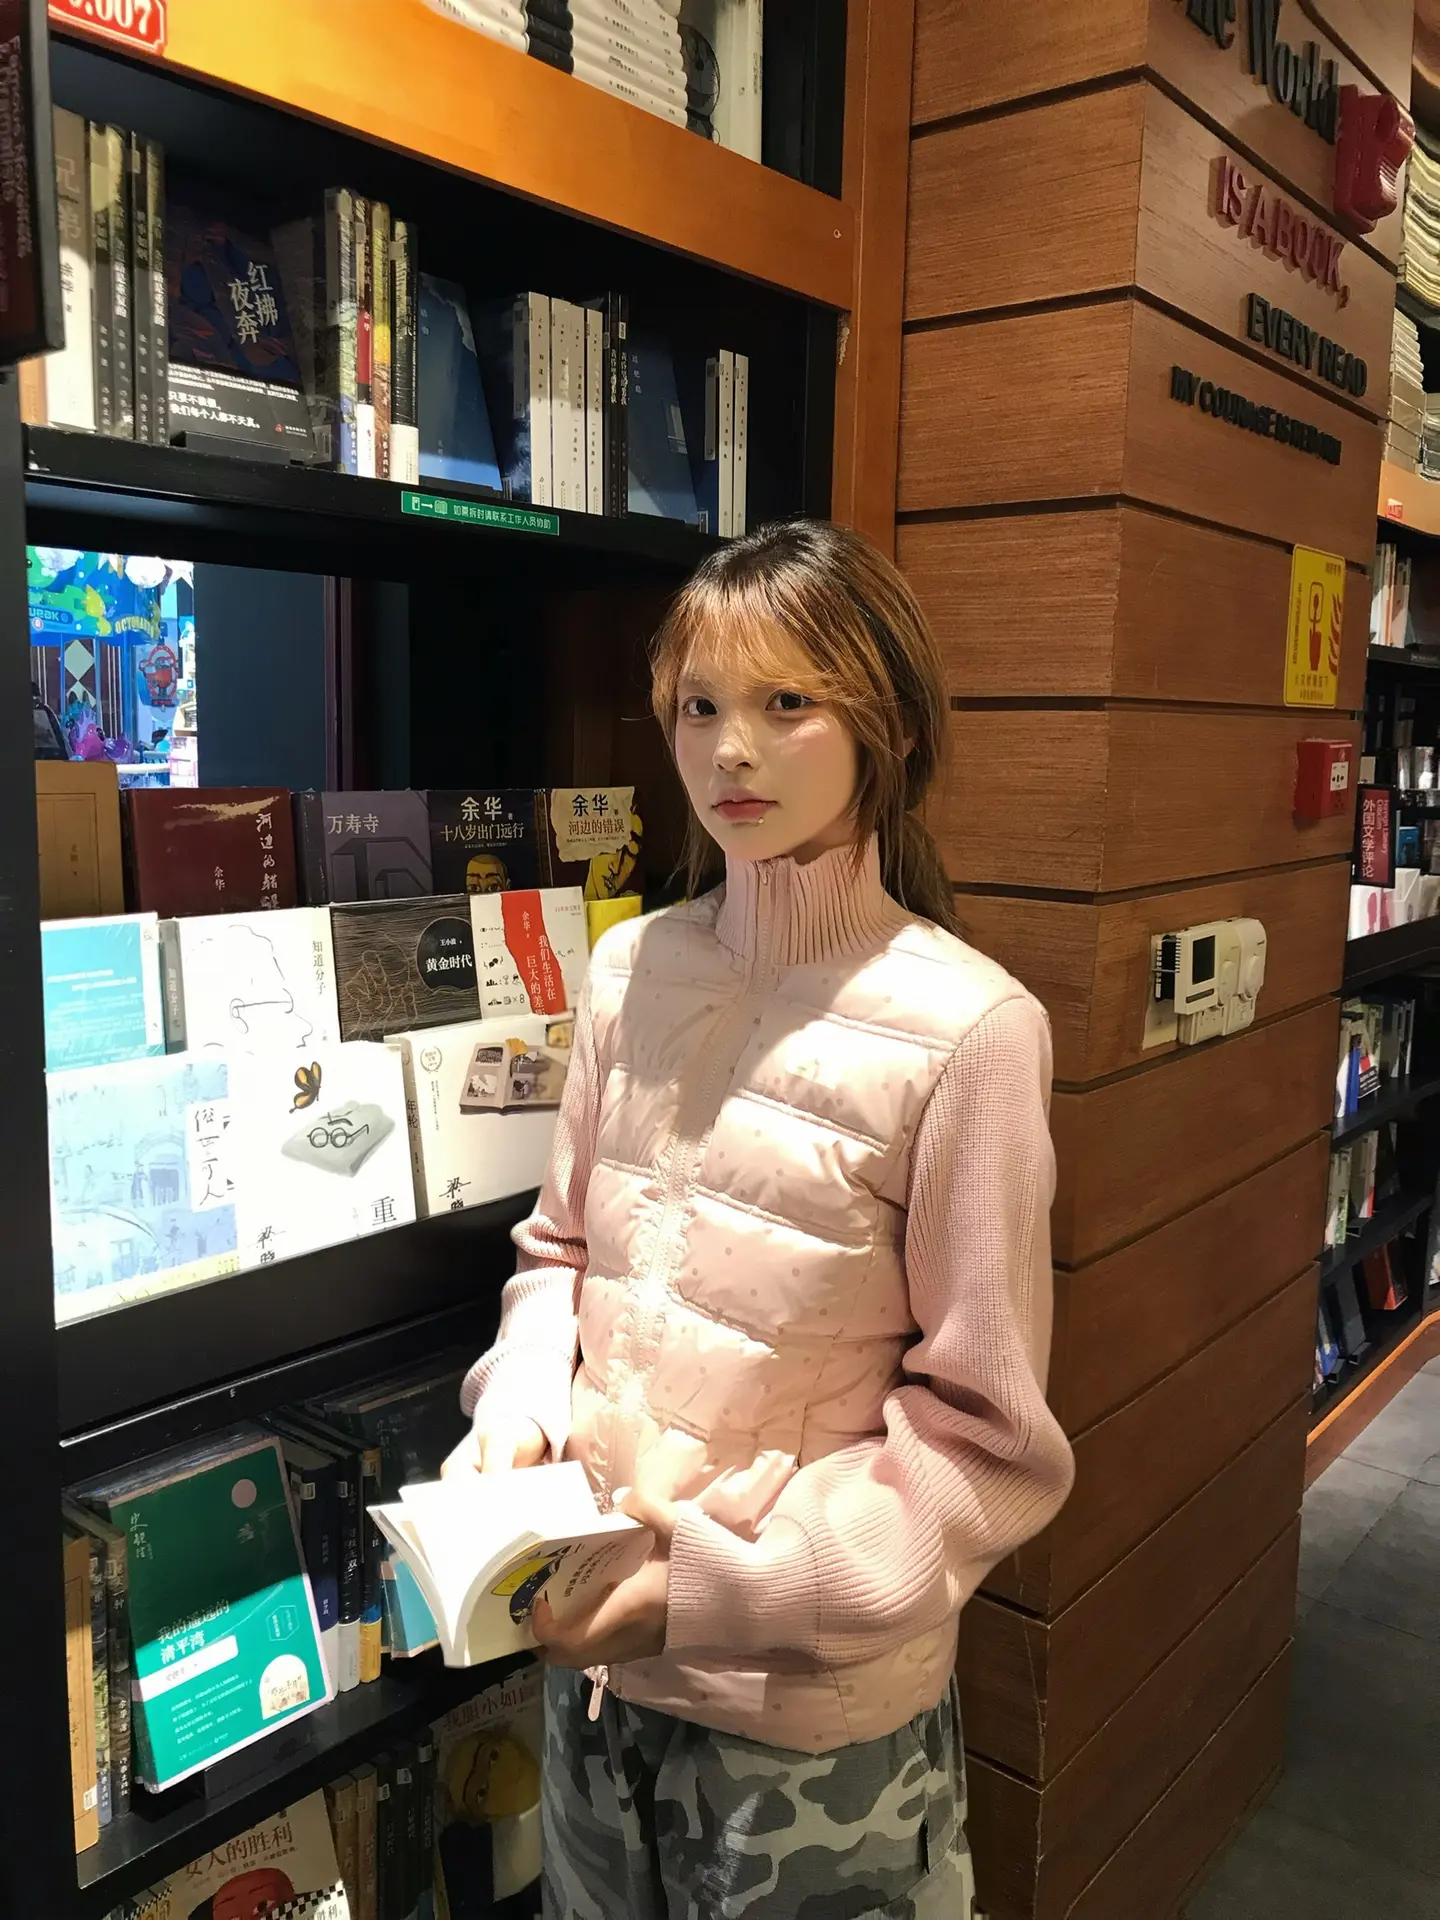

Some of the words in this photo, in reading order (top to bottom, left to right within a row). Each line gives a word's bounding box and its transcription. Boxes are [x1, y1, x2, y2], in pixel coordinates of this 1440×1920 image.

[247, 261, 279, 326] 红拂
[228, 278, 260, 344] 夜奔
[1246, 293, 1318, 371] EVERY
[1318, 335, 1367, 398] READ
[453, 504, 551, 530] 如果拆封请联系工作人员协助
[461, 796, 503, 822] 余华
[571, 794, 609, 817] 余华
[327, 813, 379, 835] 万寿寺
[440, 822, 525, 843] 十八岁出门远行
[568, 818, 625, 836] 河边的错误
[1361, 799, 1376, 878] 外国文学评论
[312, 940, 327, 995] 知道分子
[425, 954, 473, 973] 黄金时代
[538, 935, 557, 1001] 我们生活在
[371, 1196, 398, 1227] 重
[186, 1822, 293, 1879] 女人的胜利
